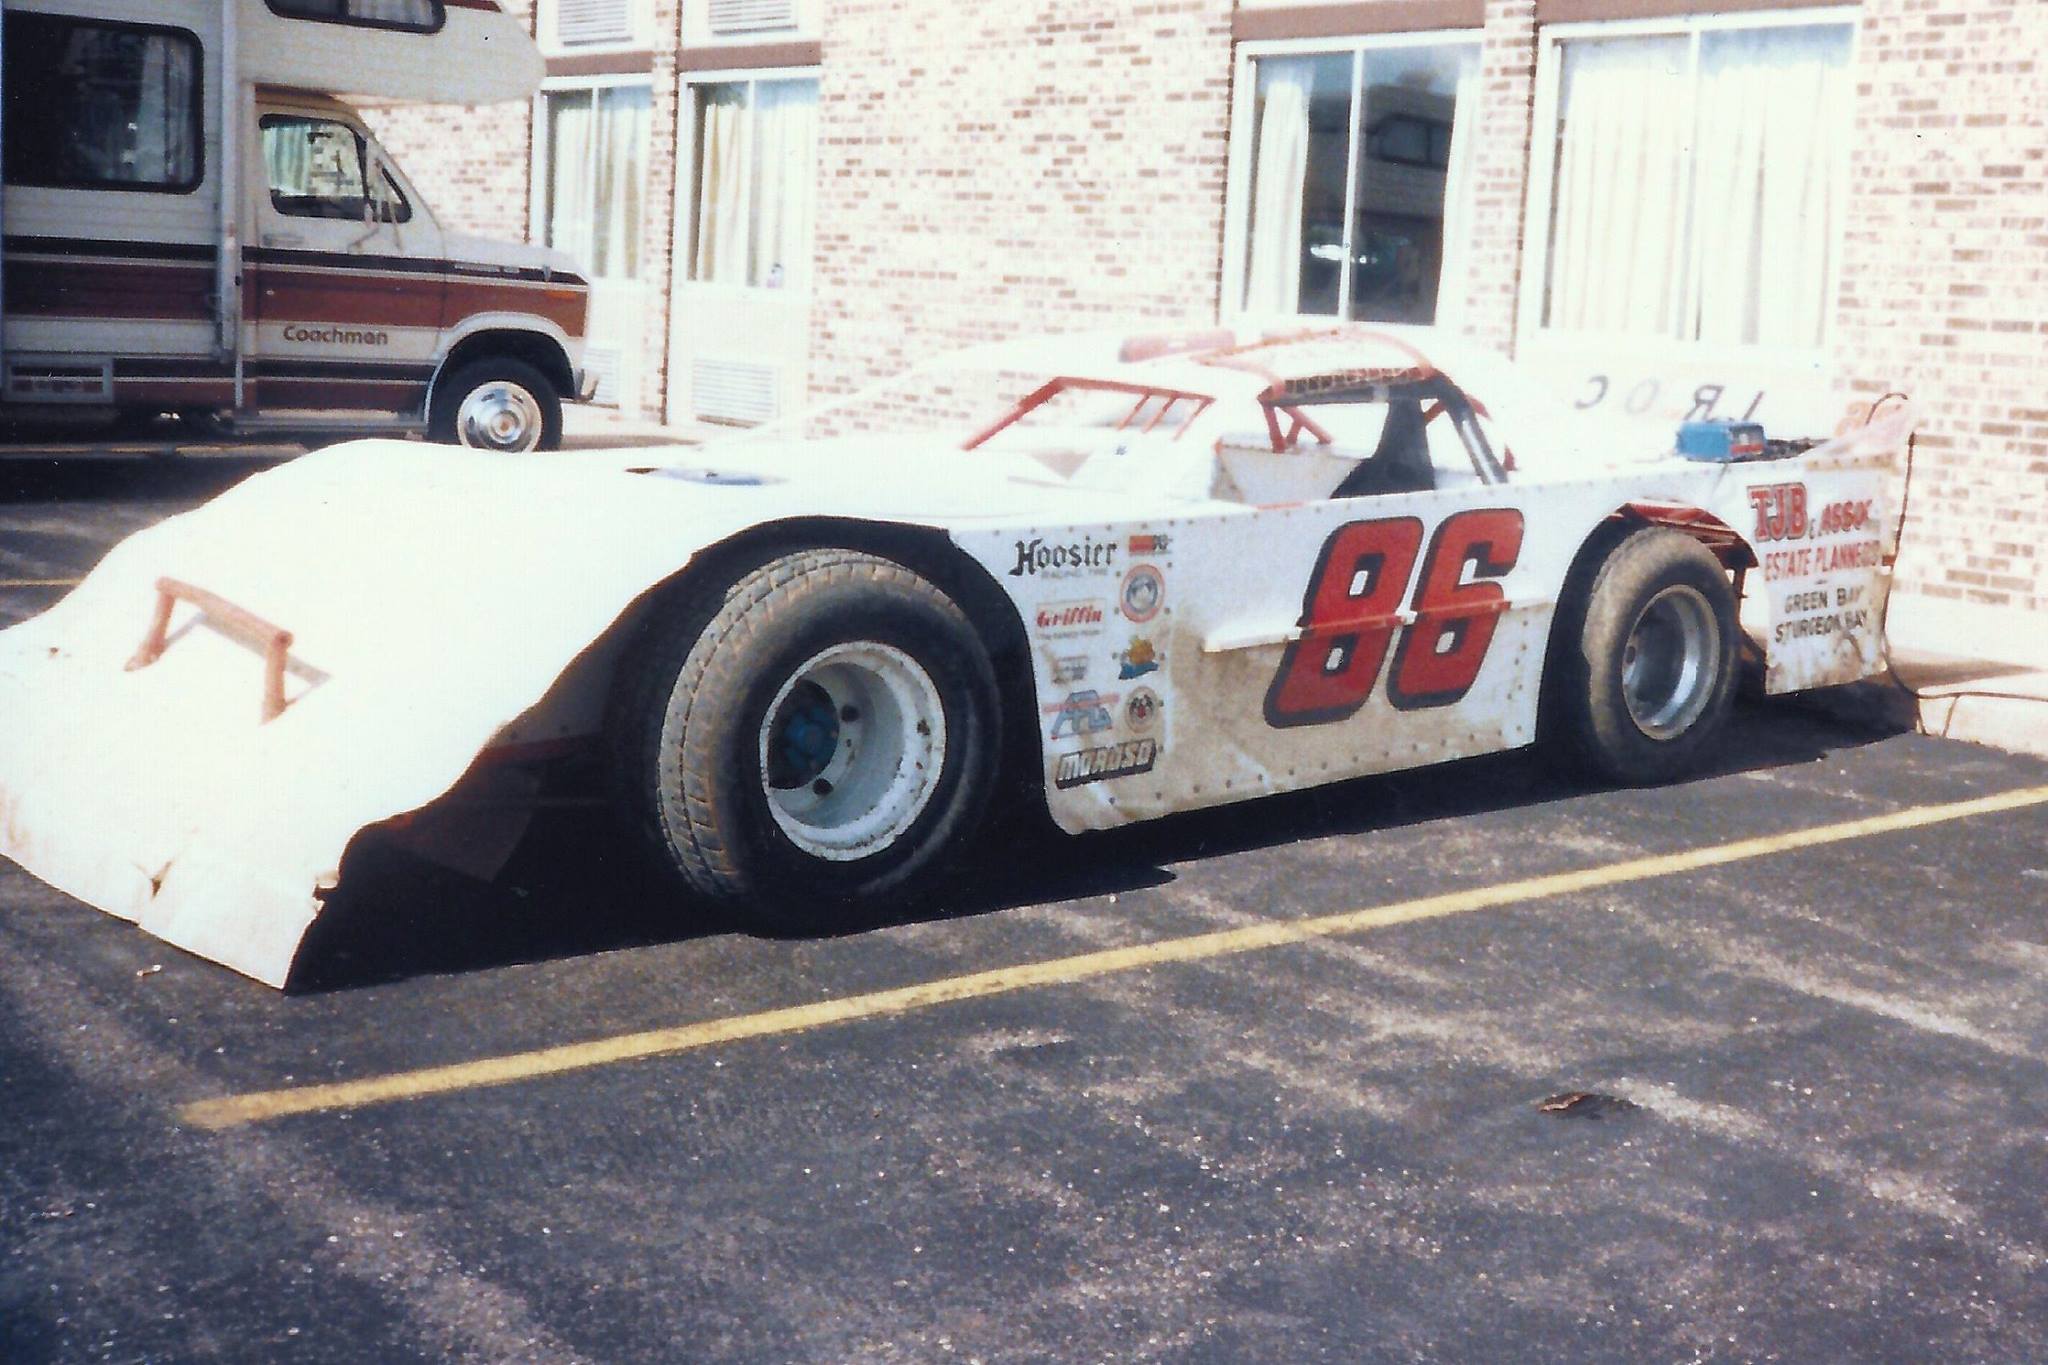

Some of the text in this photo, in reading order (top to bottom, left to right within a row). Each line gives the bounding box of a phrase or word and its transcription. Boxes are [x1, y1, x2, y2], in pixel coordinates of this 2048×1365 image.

[1746, 482, 1808, 542] TJB
[1008, 534, 1118, 576] Hoosier
[1765, 547, 1812, 582] ESTATE
[1037, 605, 1102, 627] Griffin
[1263, 508, 1525, 729] 86
[1785, 590, 1829, 614] GREEN
[1775, 614, 1841, 644] STURGEON
